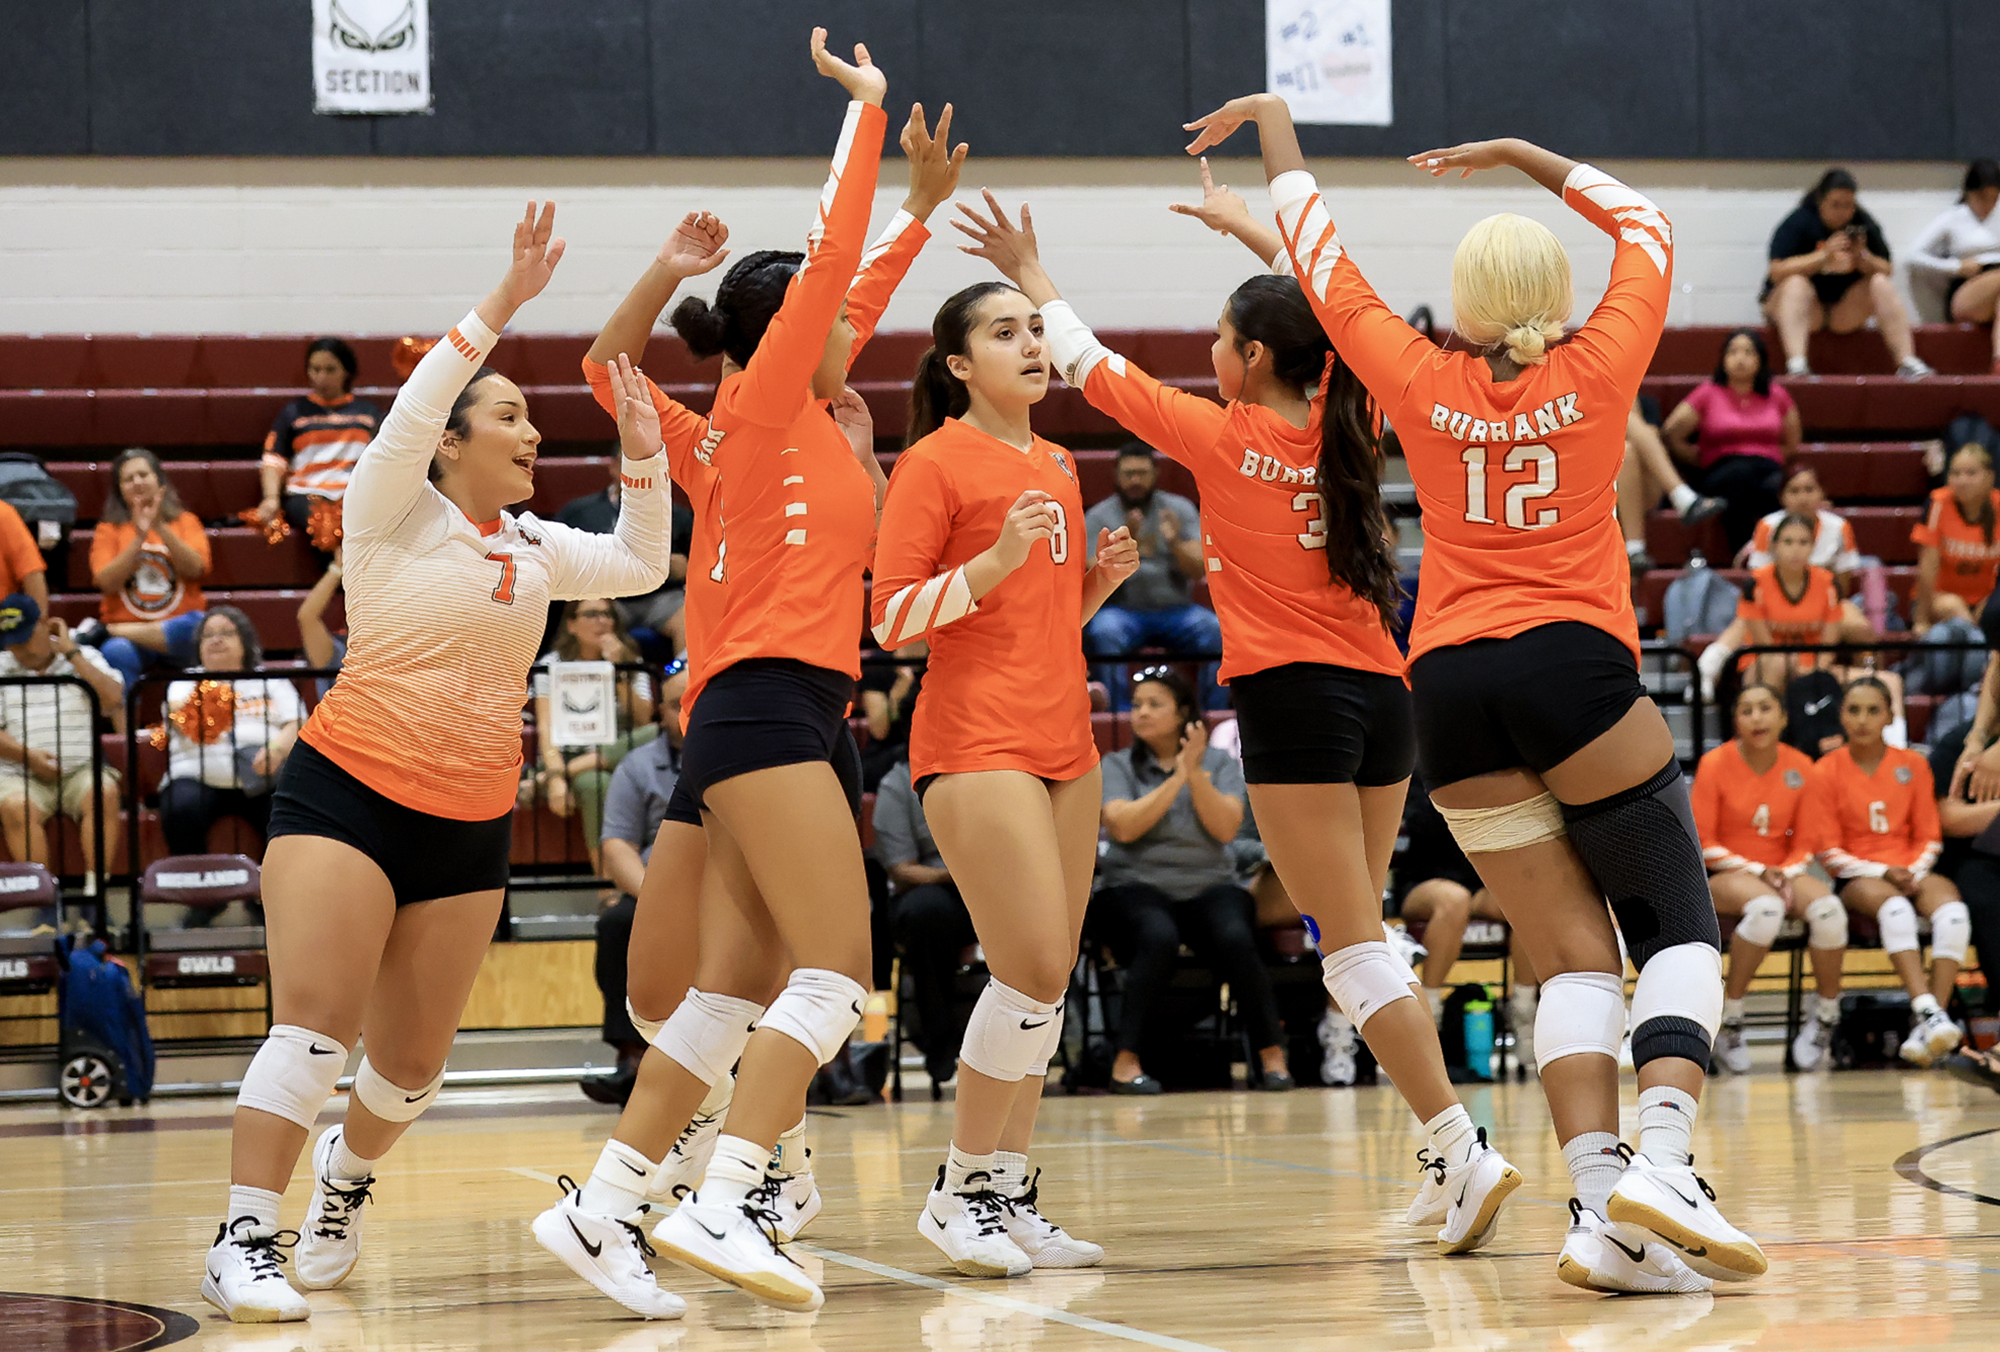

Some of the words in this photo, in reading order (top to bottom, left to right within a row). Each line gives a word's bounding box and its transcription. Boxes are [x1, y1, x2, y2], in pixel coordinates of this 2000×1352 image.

[325, 69, 420, 93] SECTION
[1429, 391, 1585, 442] BURBANK
[1239, 447, 1317, 486] BURB
[1459, 441, 1560, 531] 12
[1043, 499, 1069, 565] 8
[1292, 491, 1329, 551] 3
[1752, 803, 1771, 837] 4
[1868, 800, 1890, 834] 6
[178, 955, 236, 974] OWLS
